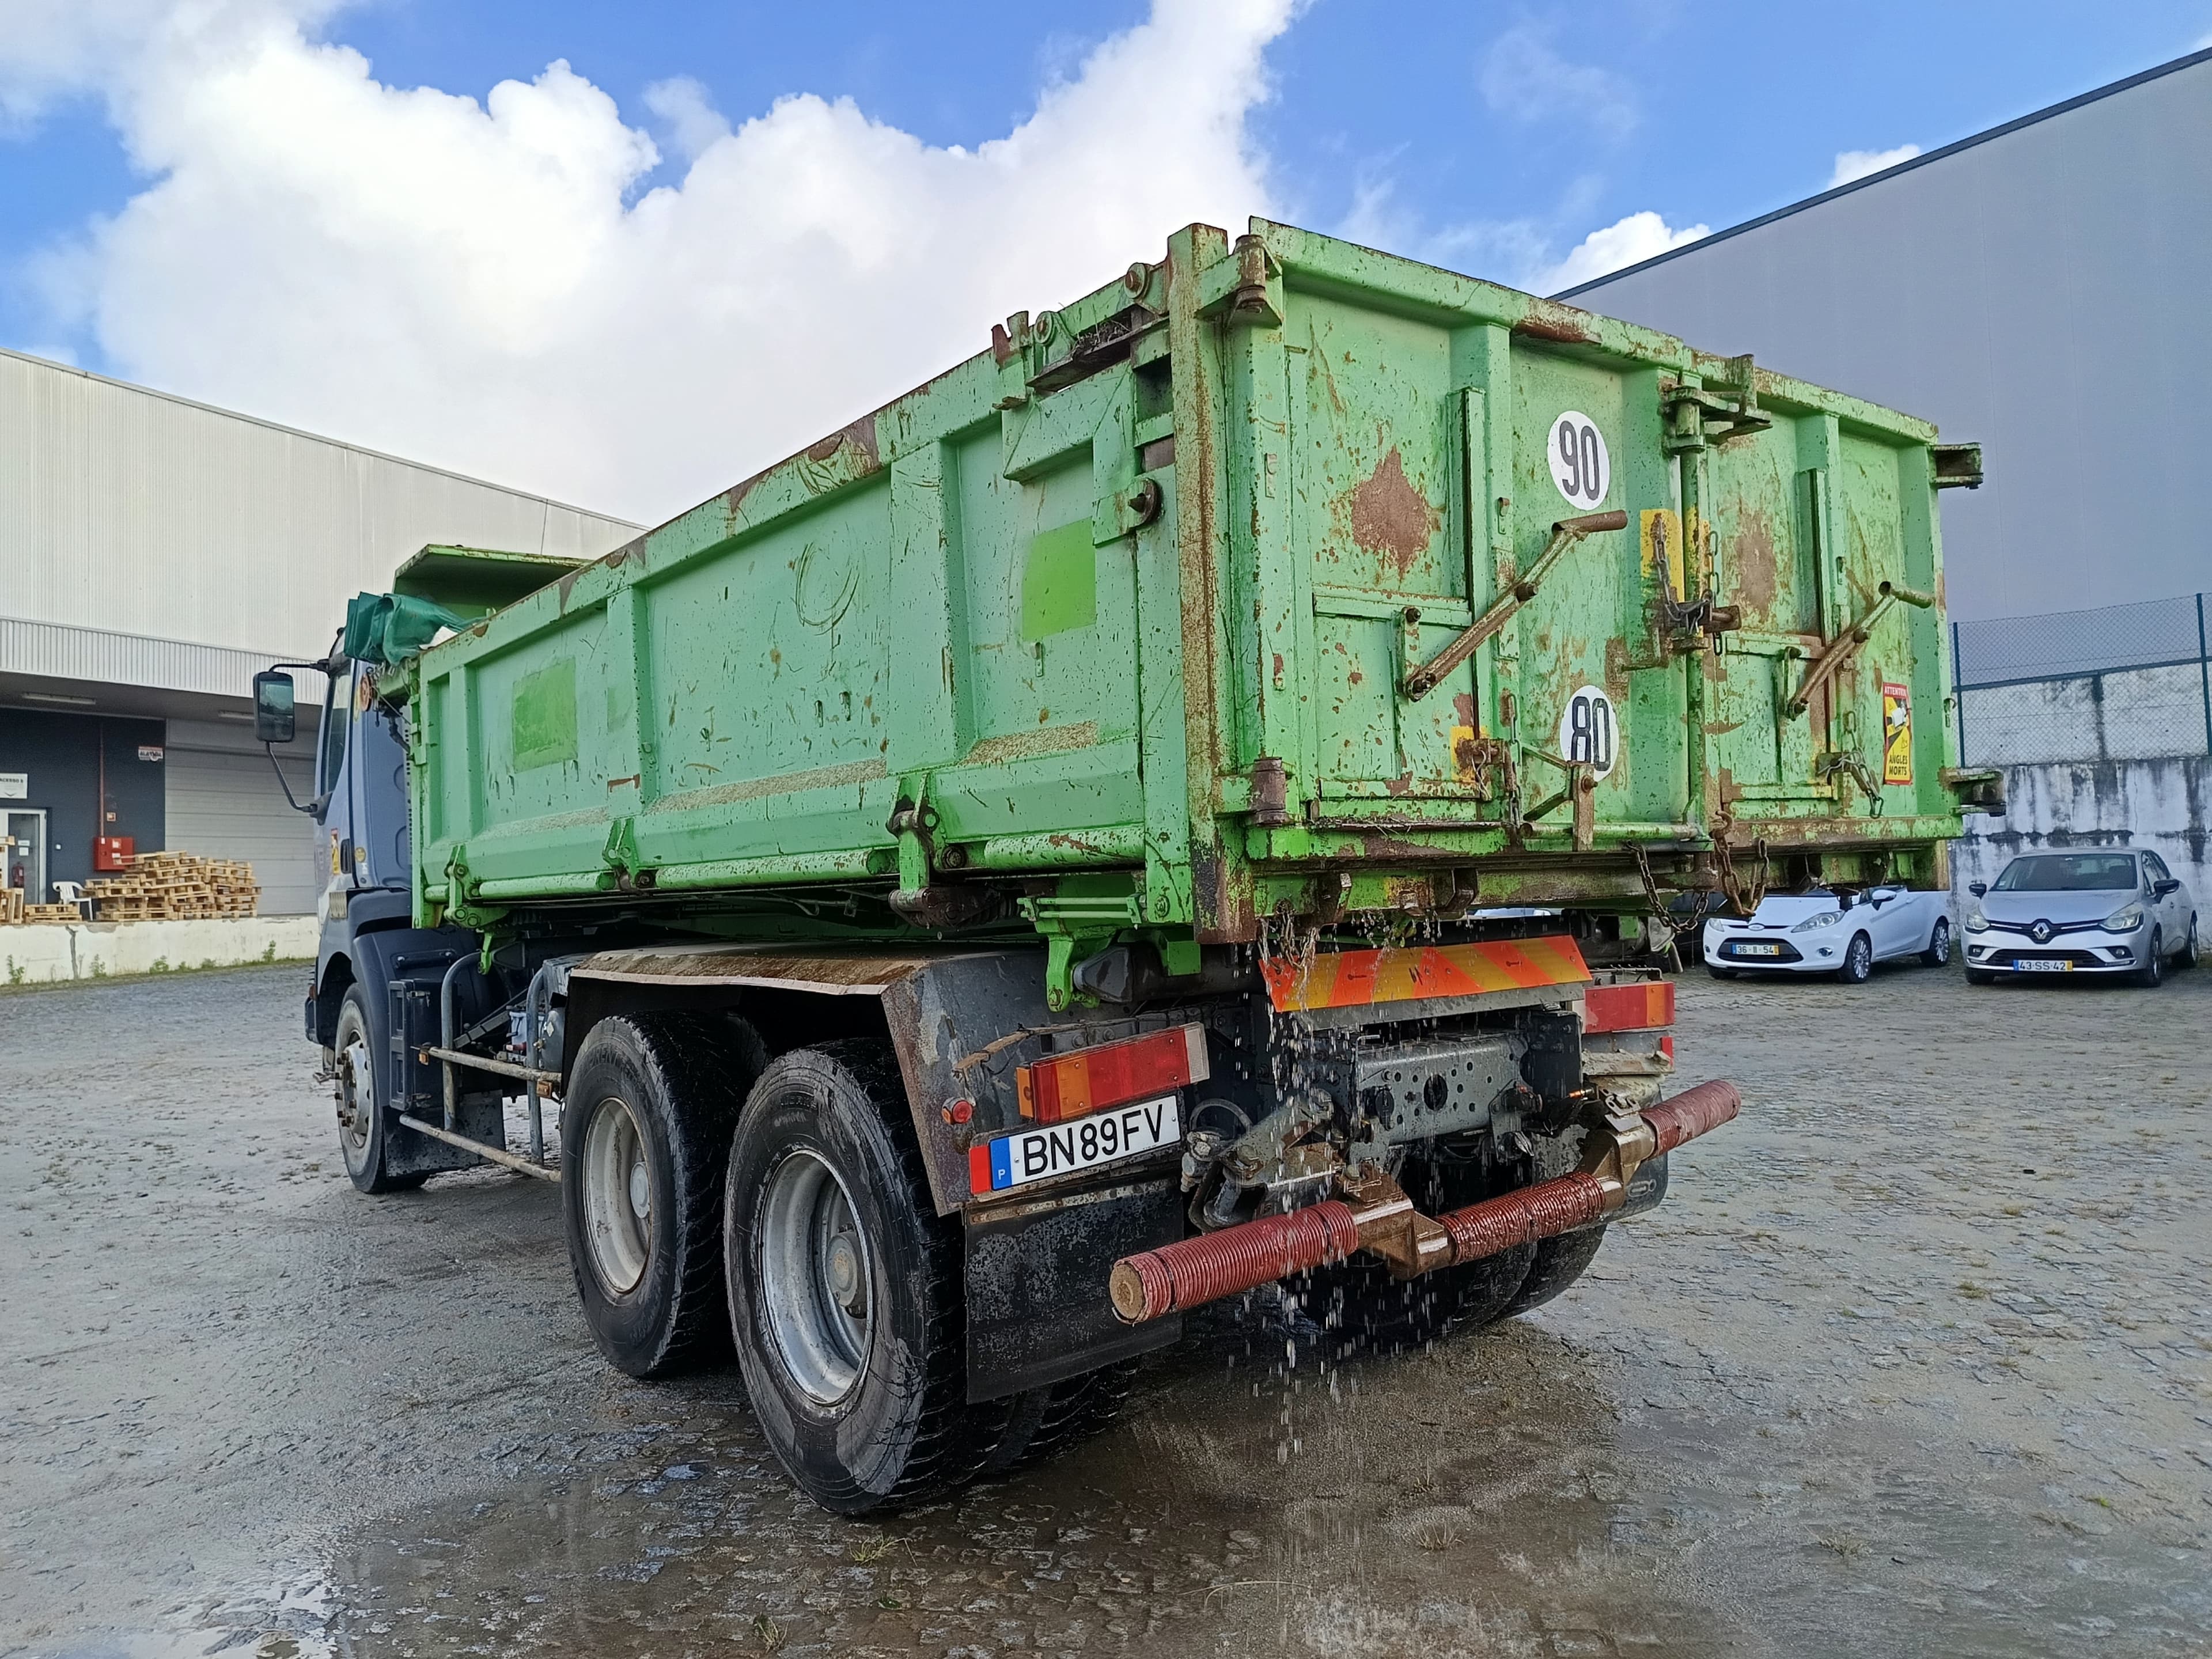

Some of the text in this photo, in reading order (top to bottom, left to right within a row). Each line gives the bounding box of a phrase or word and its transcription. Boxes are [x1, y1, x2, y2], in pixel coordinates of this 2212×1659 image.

[1559, 420, 1600, 501] 90
[1570, 695, 1611, 772] 80
[1888, 755, 1908, 764] ANGLES
[1888, 765, 1907, 776] MORTS
[998, 1104, 1163, 1180] P BN89FV
